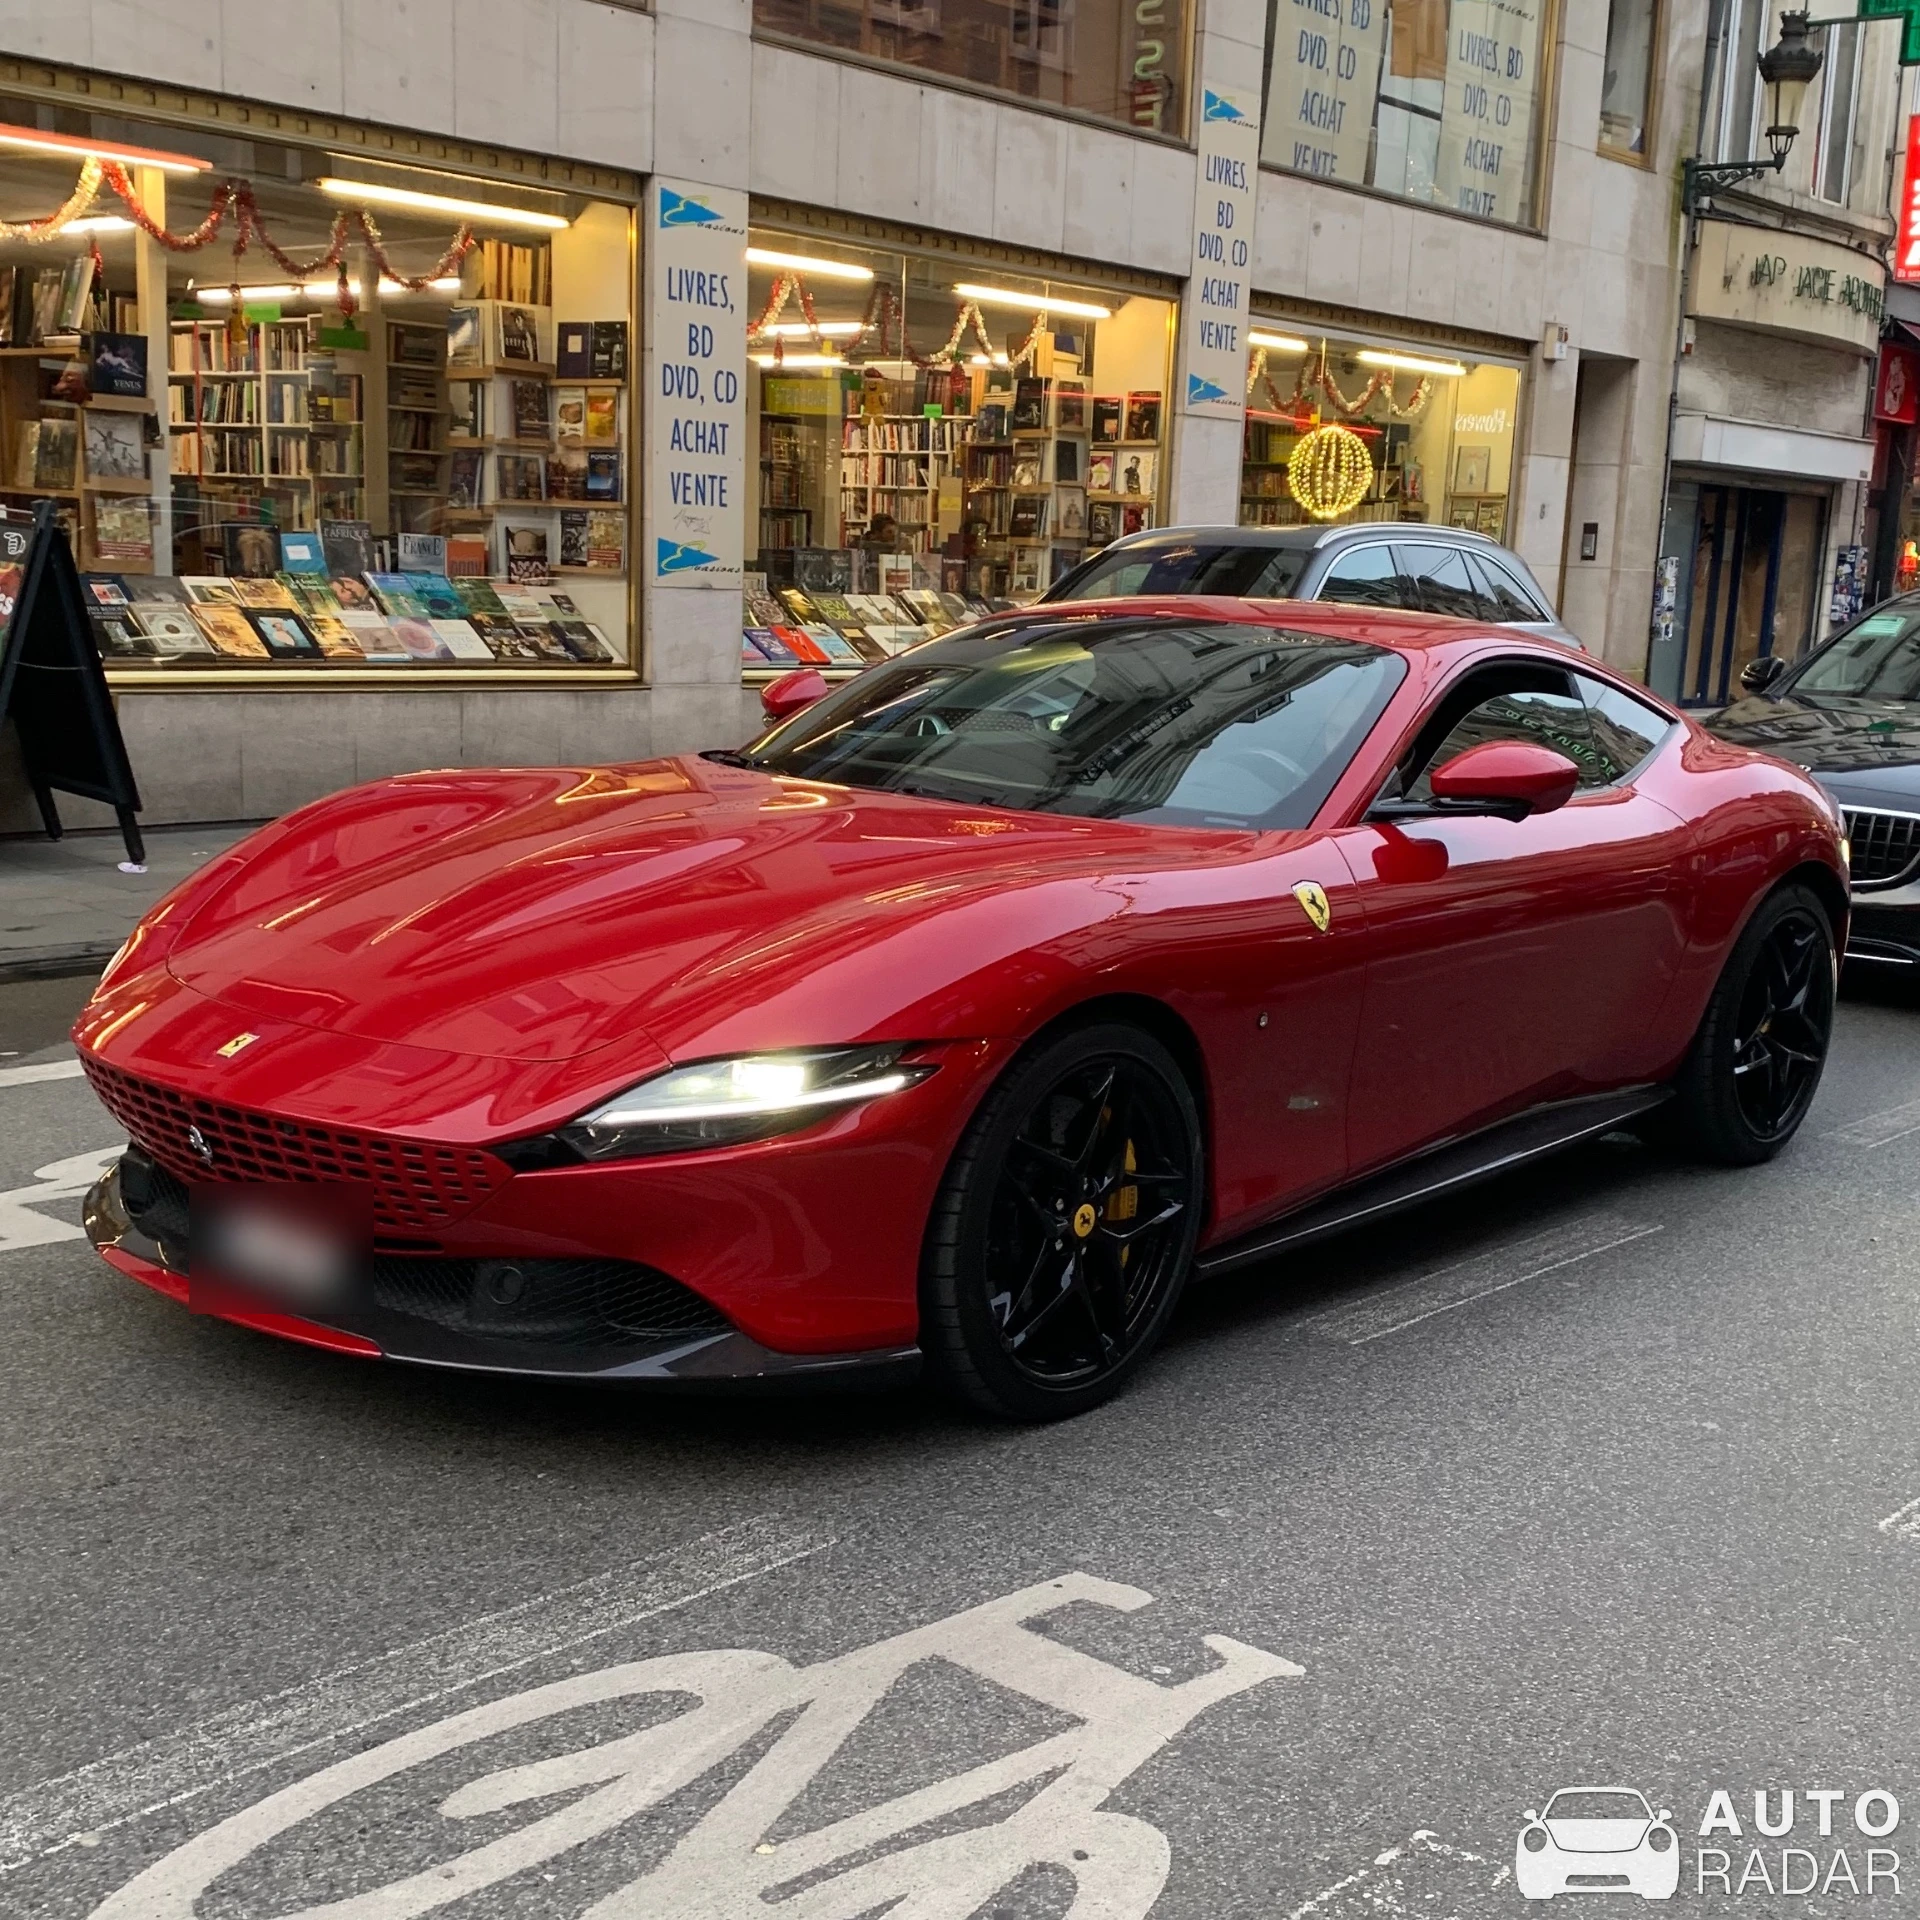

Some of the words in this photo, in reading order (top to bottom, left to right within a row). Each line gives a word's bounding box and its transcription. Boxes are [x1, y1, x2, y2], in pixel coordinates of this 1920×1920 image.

[1351, 0, 1370, 29] BD
[1298, 30, 1330, 76] DVD,
[1338, 45, 1356, 80] CD
[1459, 29, 1501, 78] LIVRES,
[1507, 47, 1523, 79] BD
[1299, 88, 1346, 134] ACHAT
[1463, 83, 1489, 124] DVD,
[1496, 94, 1511, 126] CD
[1206, 154, 1249, 193] LIVRES,
[1464, 136, 1503, 176] ACHAT
[1217, 200, 1234, 228] BD
[1199, 232, 1226, 267] DVD,
[1232, 240, 1248, 267] CD
[668, 267, 734, 314] LIVRES,
[1201, 277, 1240, 309] ACHAT
[688, 323, 713, 358] BD
[1200, 320, 1237, 352] VENTE
[663, 364, 704, 405] DVD,
[714, 370, 737, 404] CD
[670, 418, 729, 455] ACHAT
[670, 472, 728, 507] VENTE
